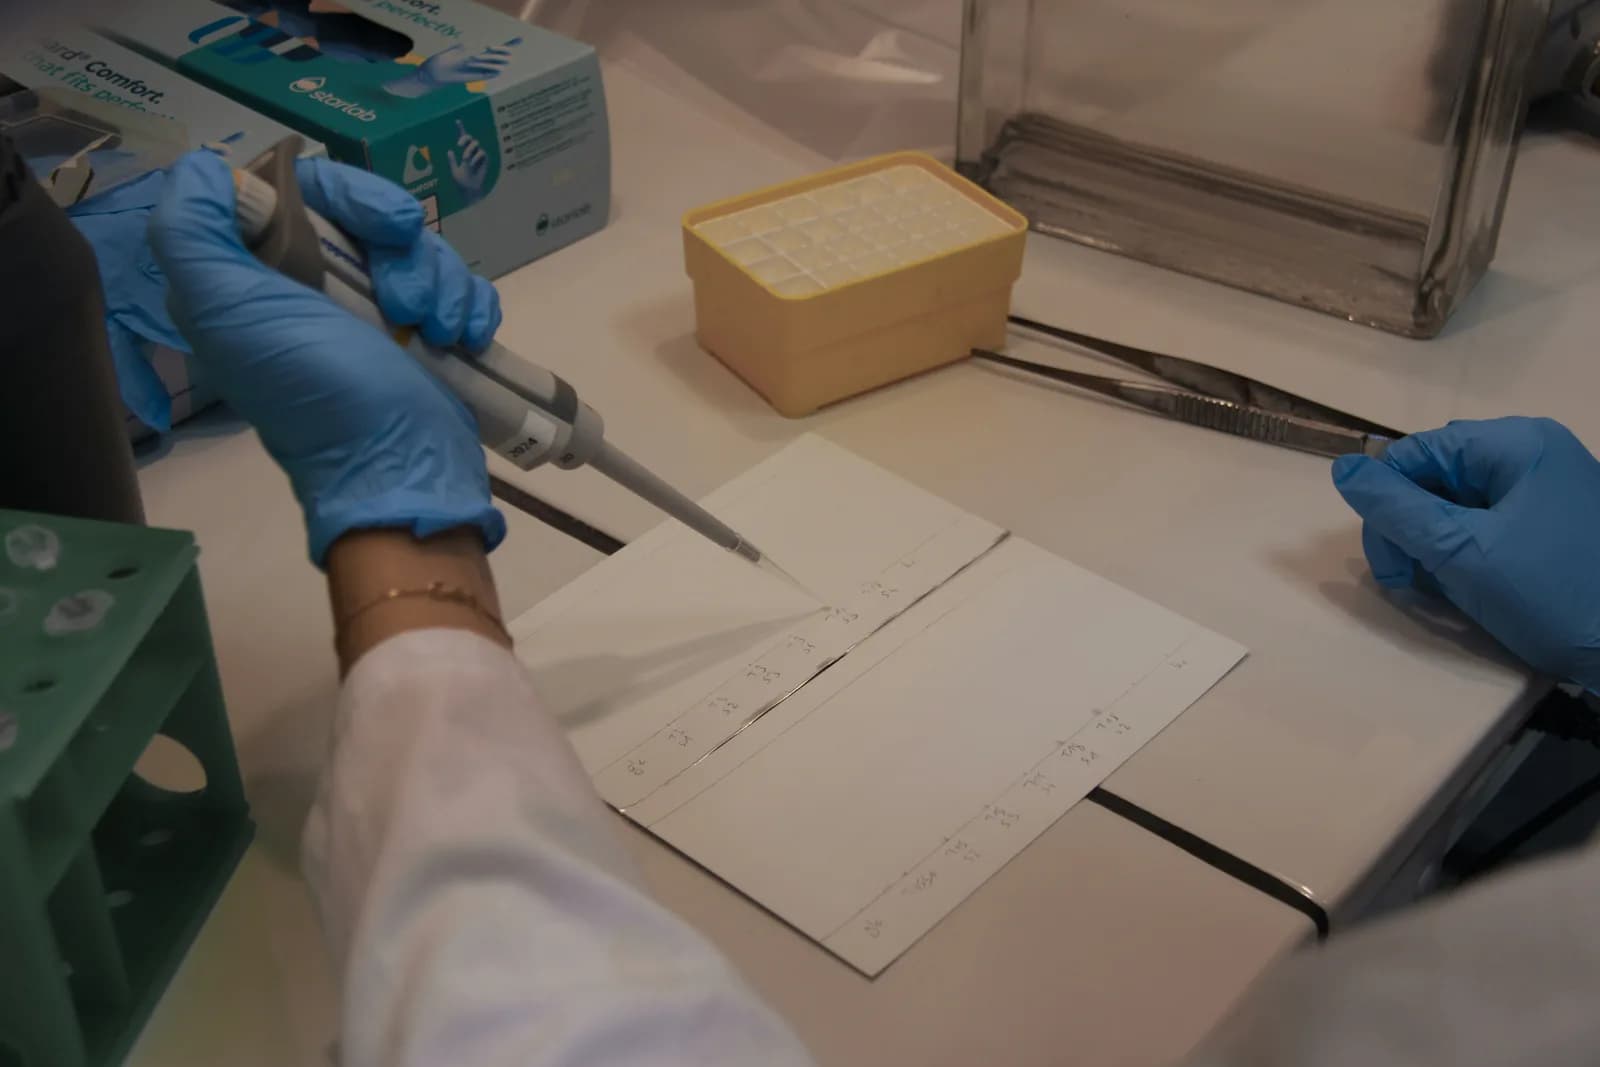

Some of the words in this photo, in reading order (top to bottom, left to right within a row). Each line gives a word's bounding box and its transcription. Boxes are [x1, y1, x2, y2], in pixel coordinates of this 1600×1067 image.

[62, 70, 97, 93] fits
[85, 61, 164, 105] Comfort.
[309, 89, 377, 122] starlab
